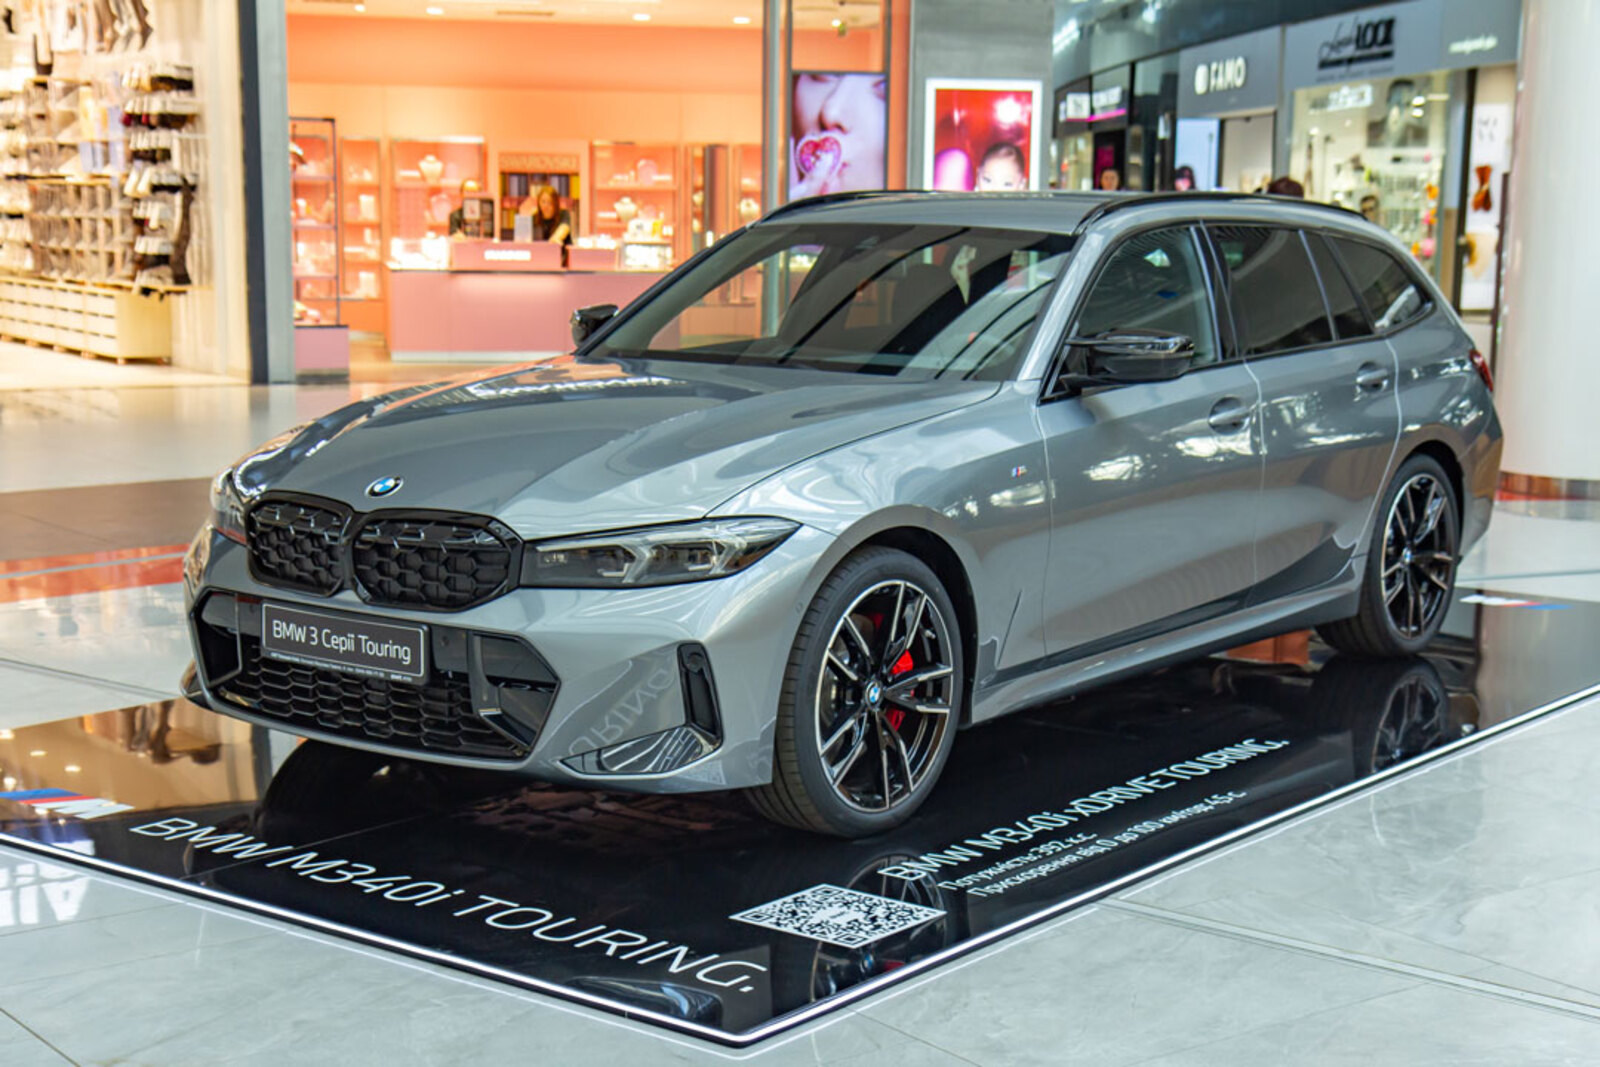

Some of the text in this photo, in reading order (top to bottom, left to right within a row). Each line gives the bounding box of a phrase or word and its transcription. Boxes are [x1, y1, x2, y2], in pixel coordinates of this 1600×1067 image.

[272, 619, 307, 643] BMW
[309, 627, 318, 646] 3
[357, 635, 412, 665] Touring
[876, 738, 1291, 883] BMW M340i xDRIVE TOURING.
[1029, 840, 1074, 856] 392
[966, 854, 1084, 898] Прискорення
[1114, 832, 1139, 844] до
[1127, 820, 1165, 834] 100
[128, 817, 768, 993] BMW M340i TOURING.
